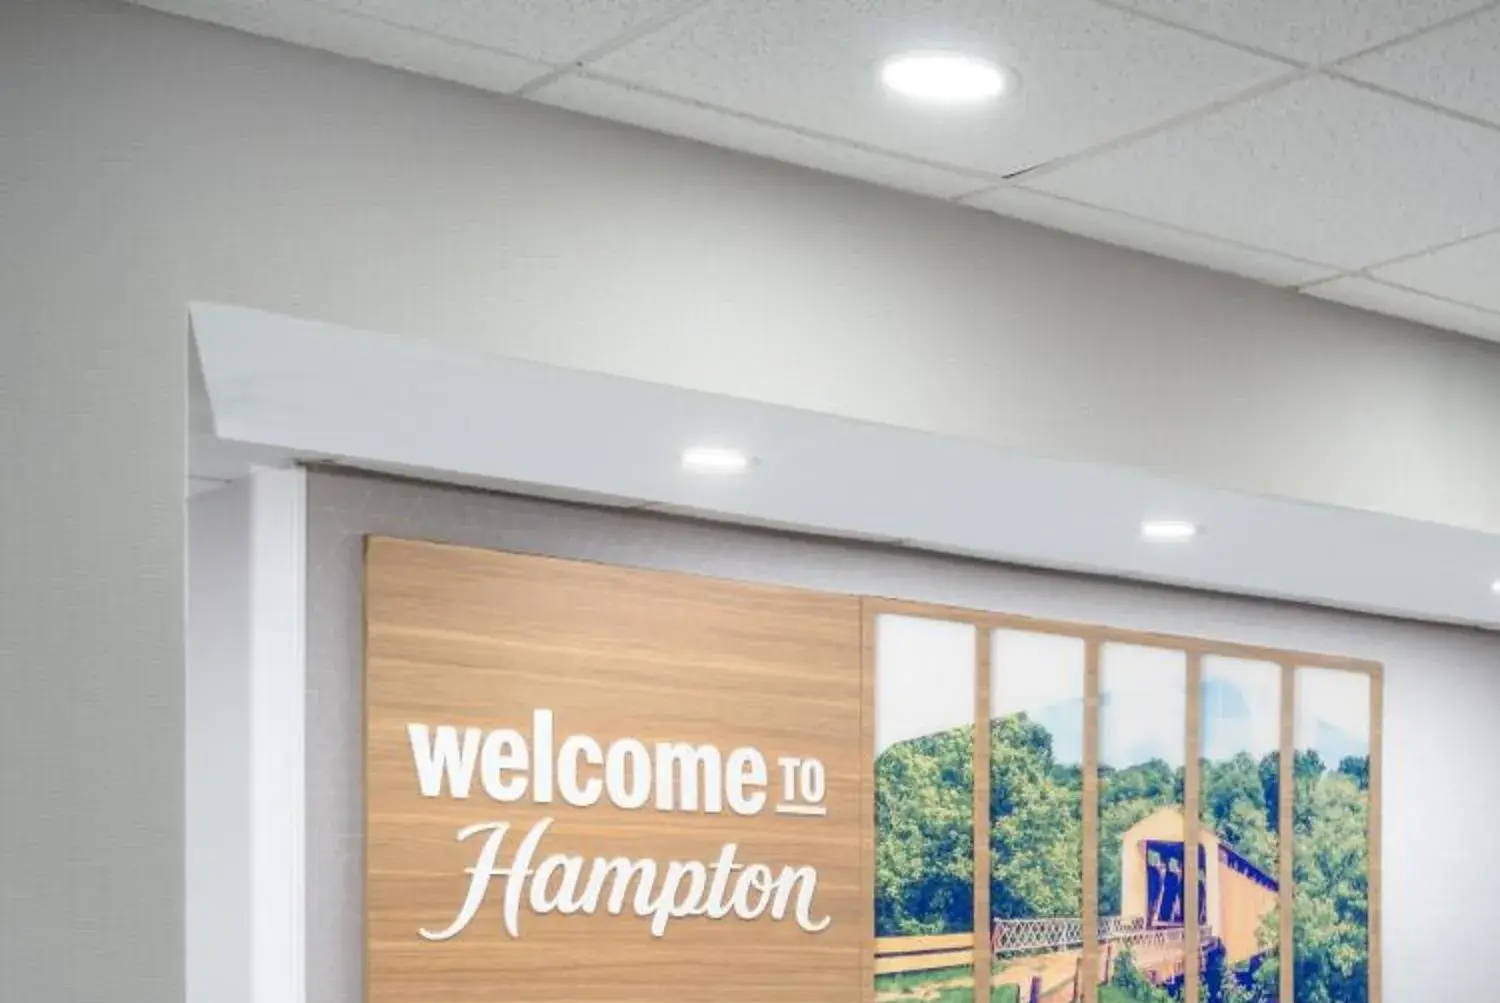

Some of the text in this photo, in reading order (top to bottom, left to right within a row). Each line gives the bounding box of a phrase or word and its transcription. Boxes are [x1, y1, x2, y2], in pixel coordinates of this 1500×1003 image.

[408, 708, 827, 816] welcome TO
[418, 817, 831, 940] Hampton
